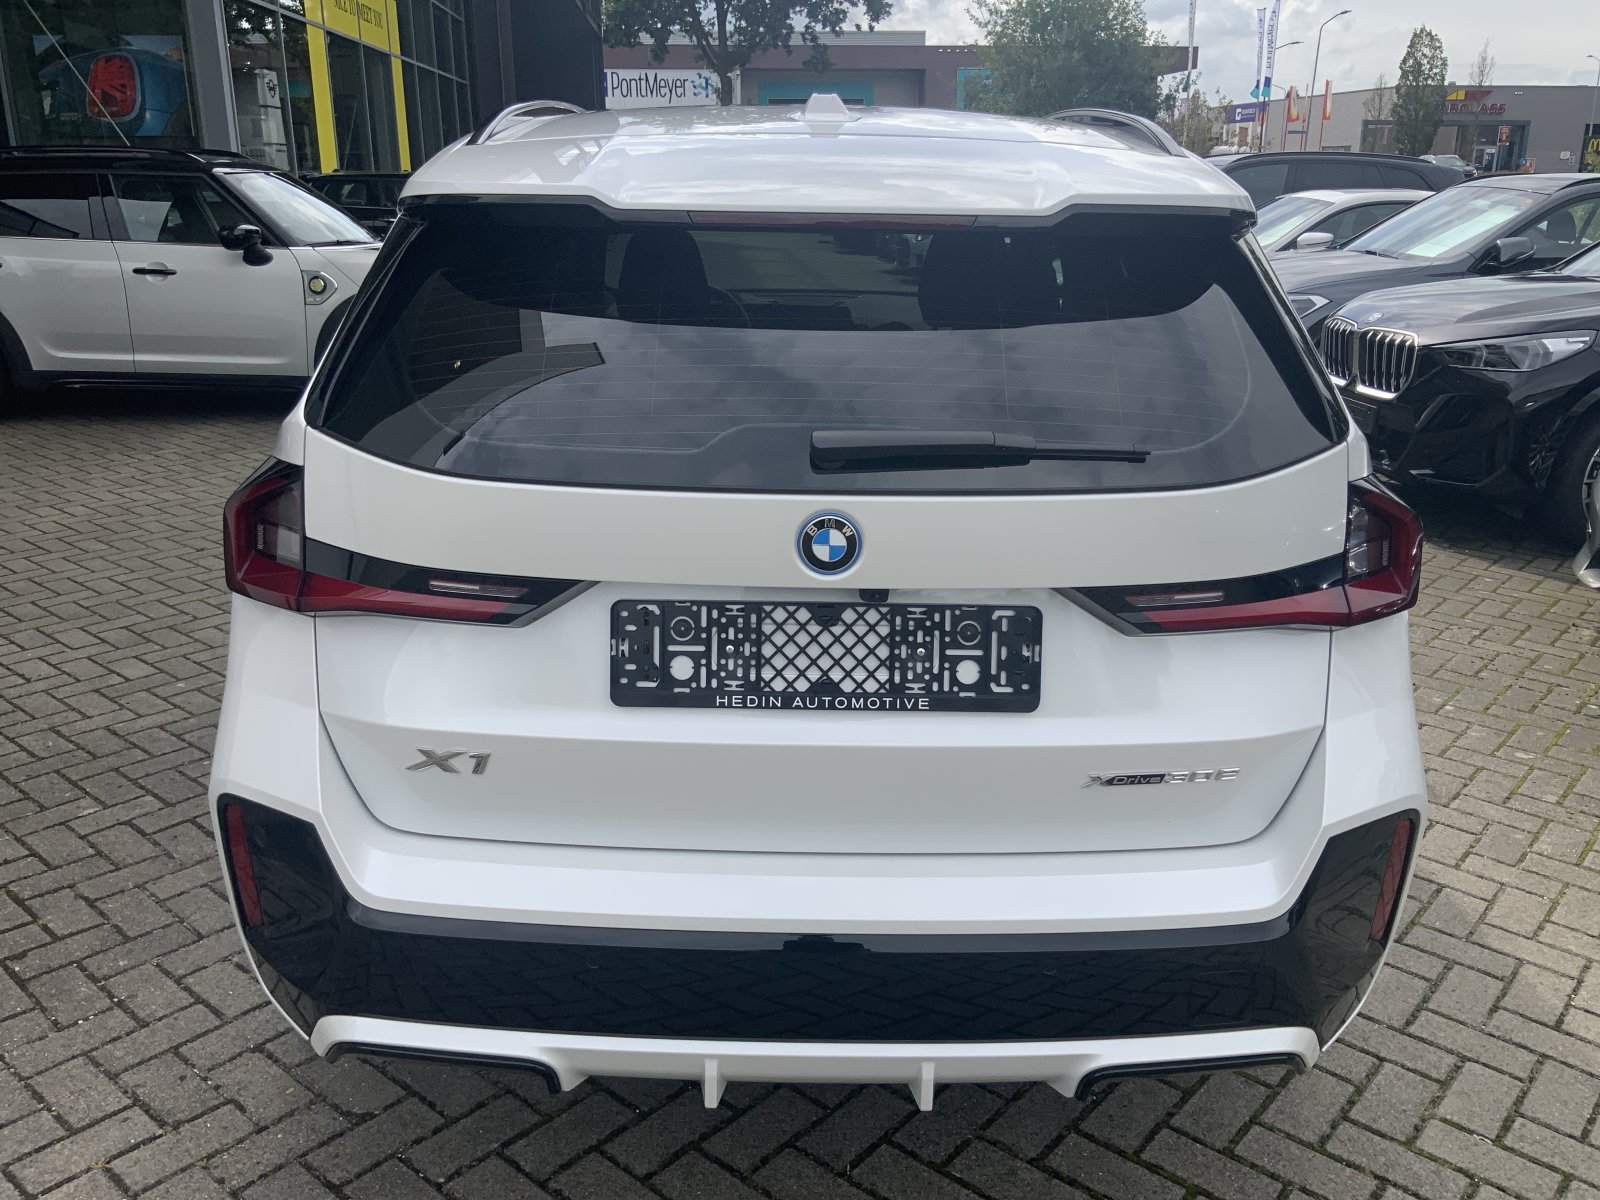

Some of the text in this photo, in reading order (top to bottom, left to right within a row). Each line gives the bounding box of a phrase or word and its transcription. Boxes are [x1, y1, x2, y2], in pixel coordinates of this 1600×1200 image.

[610, 71, 689, 105] PontMeyer
[807, 518, 854, 537] BMW
[716, 695, 930, 710] HEDIN AUTOMOTIVE
[404, 746, 491, 775] X1
